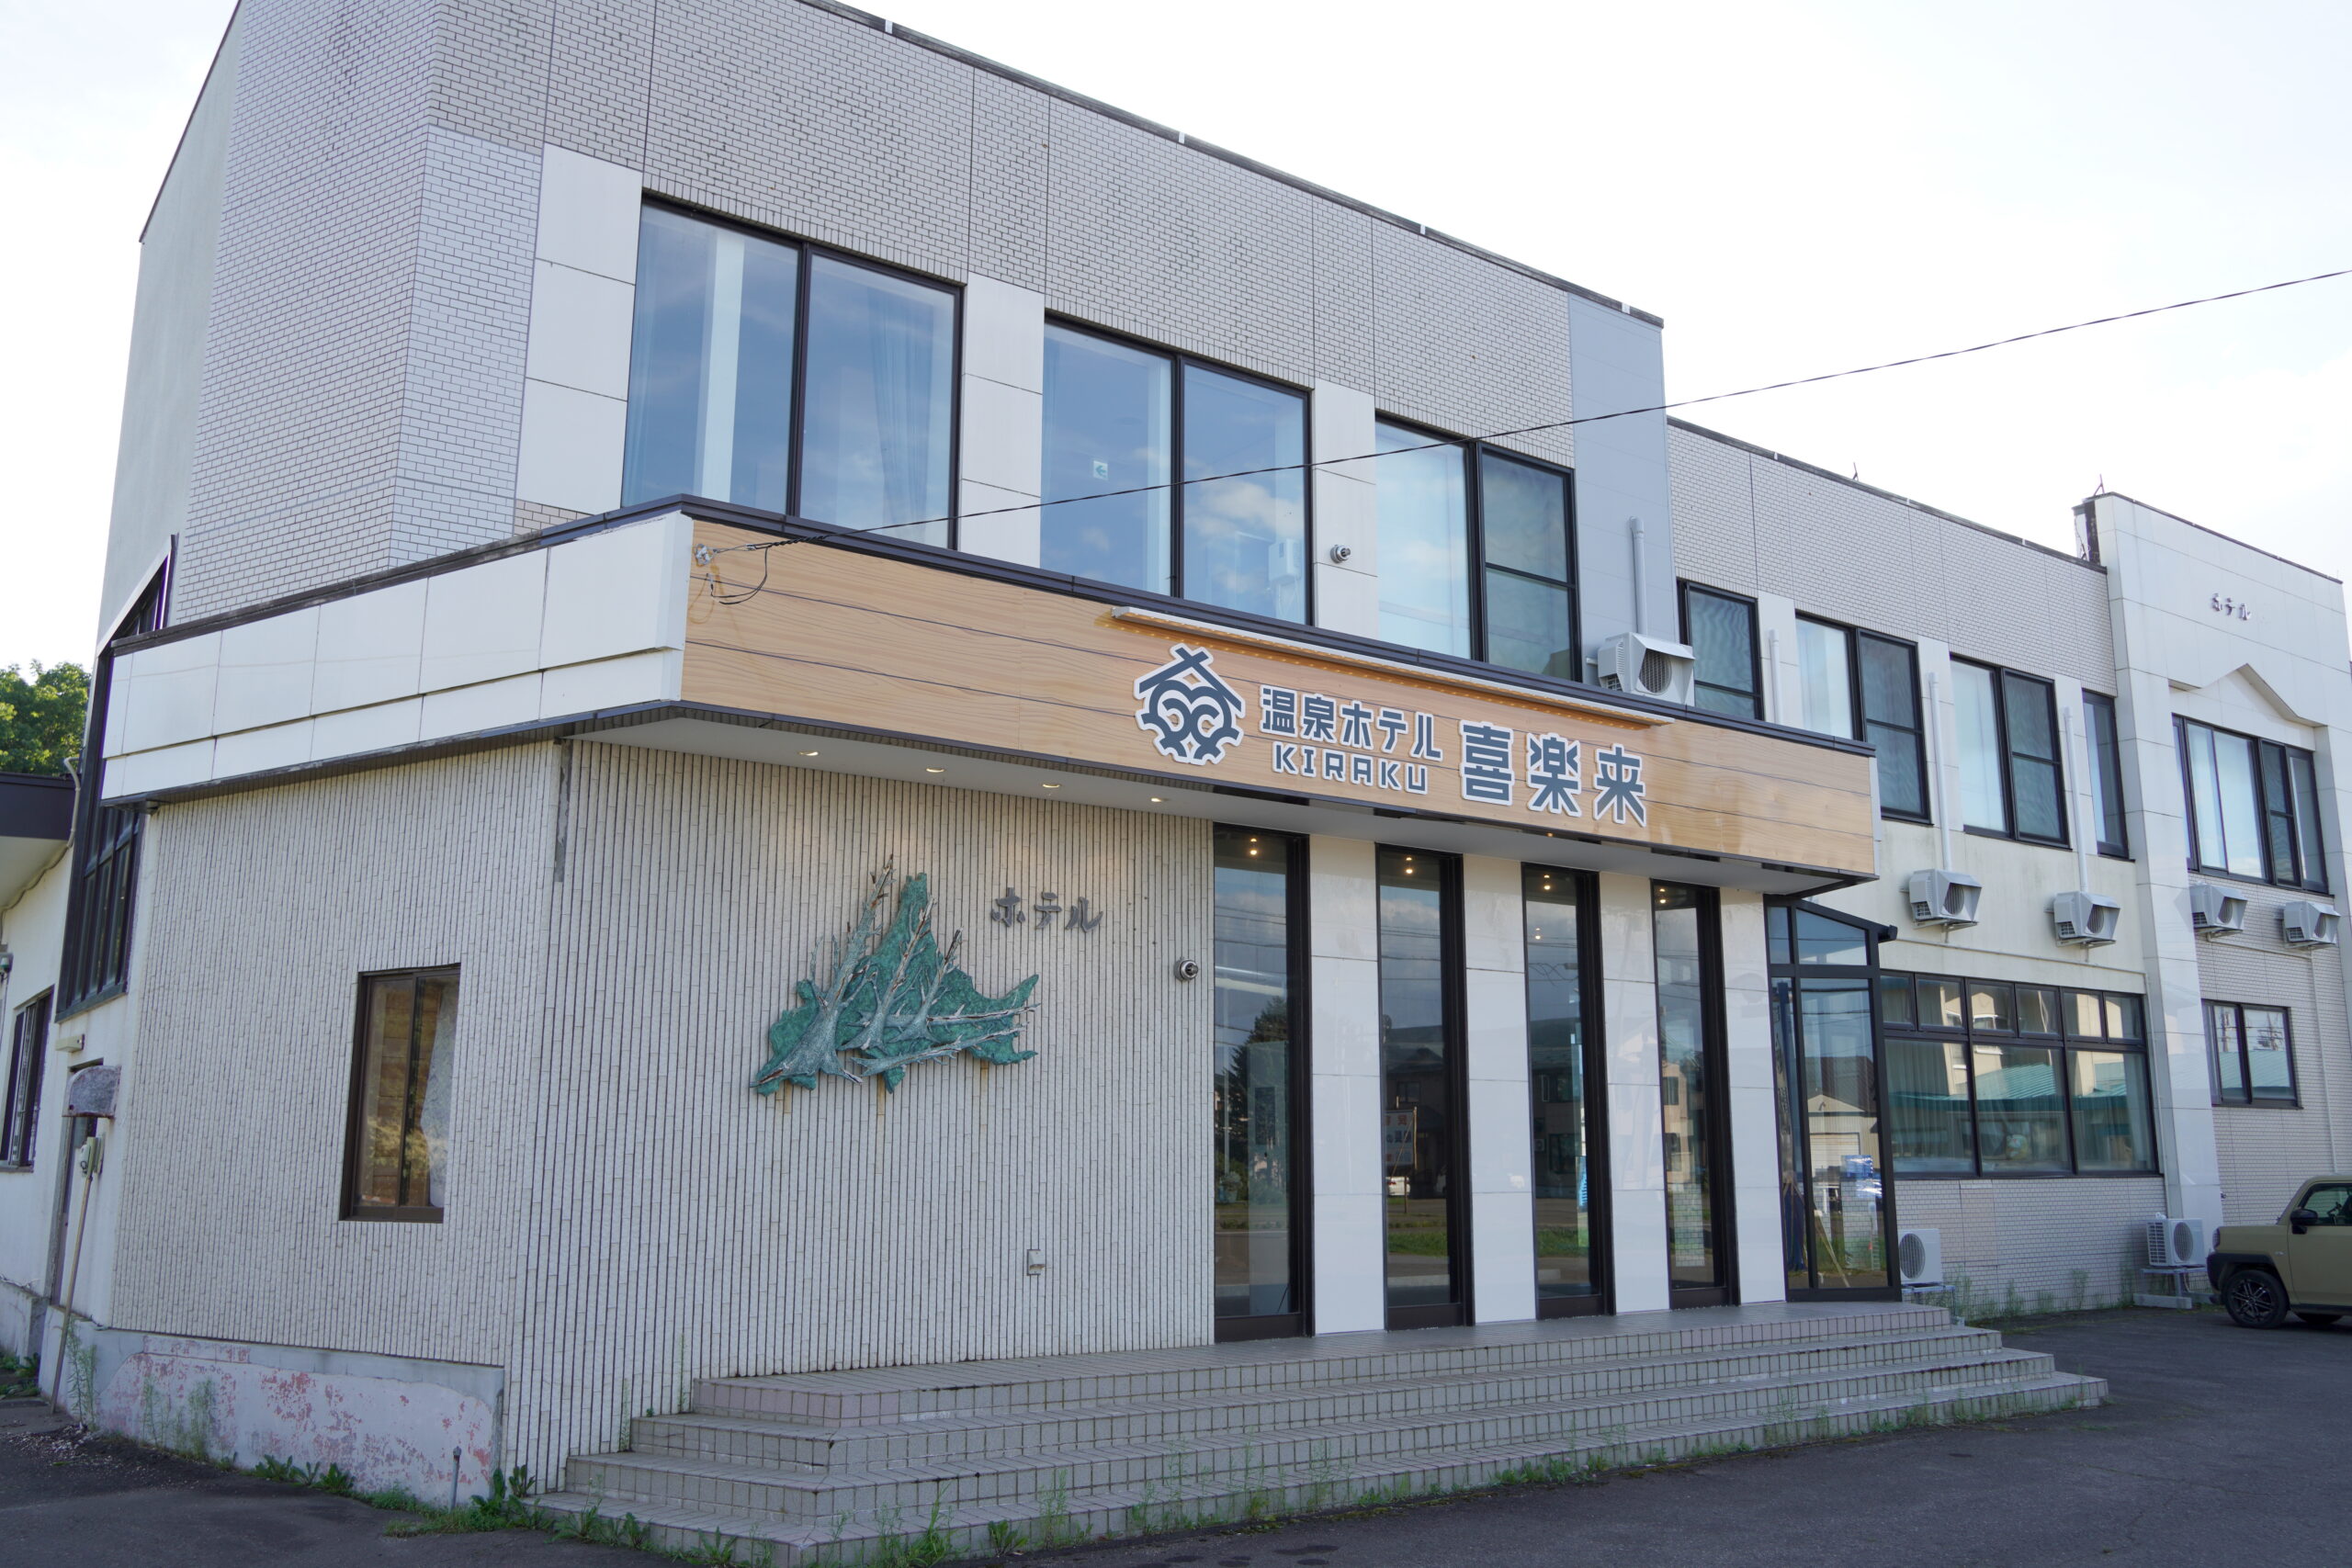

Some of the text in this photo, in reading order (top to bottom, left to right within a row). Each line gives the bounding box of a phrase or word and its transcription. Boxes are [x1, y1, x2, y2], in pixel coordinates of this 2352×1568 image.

[1261, 686, 1645, 826] 温泉ホテル 喜楽来
[1274, 743, 1427, 794] KIRAKU
[990, 887, 1103, 932] ホテル
